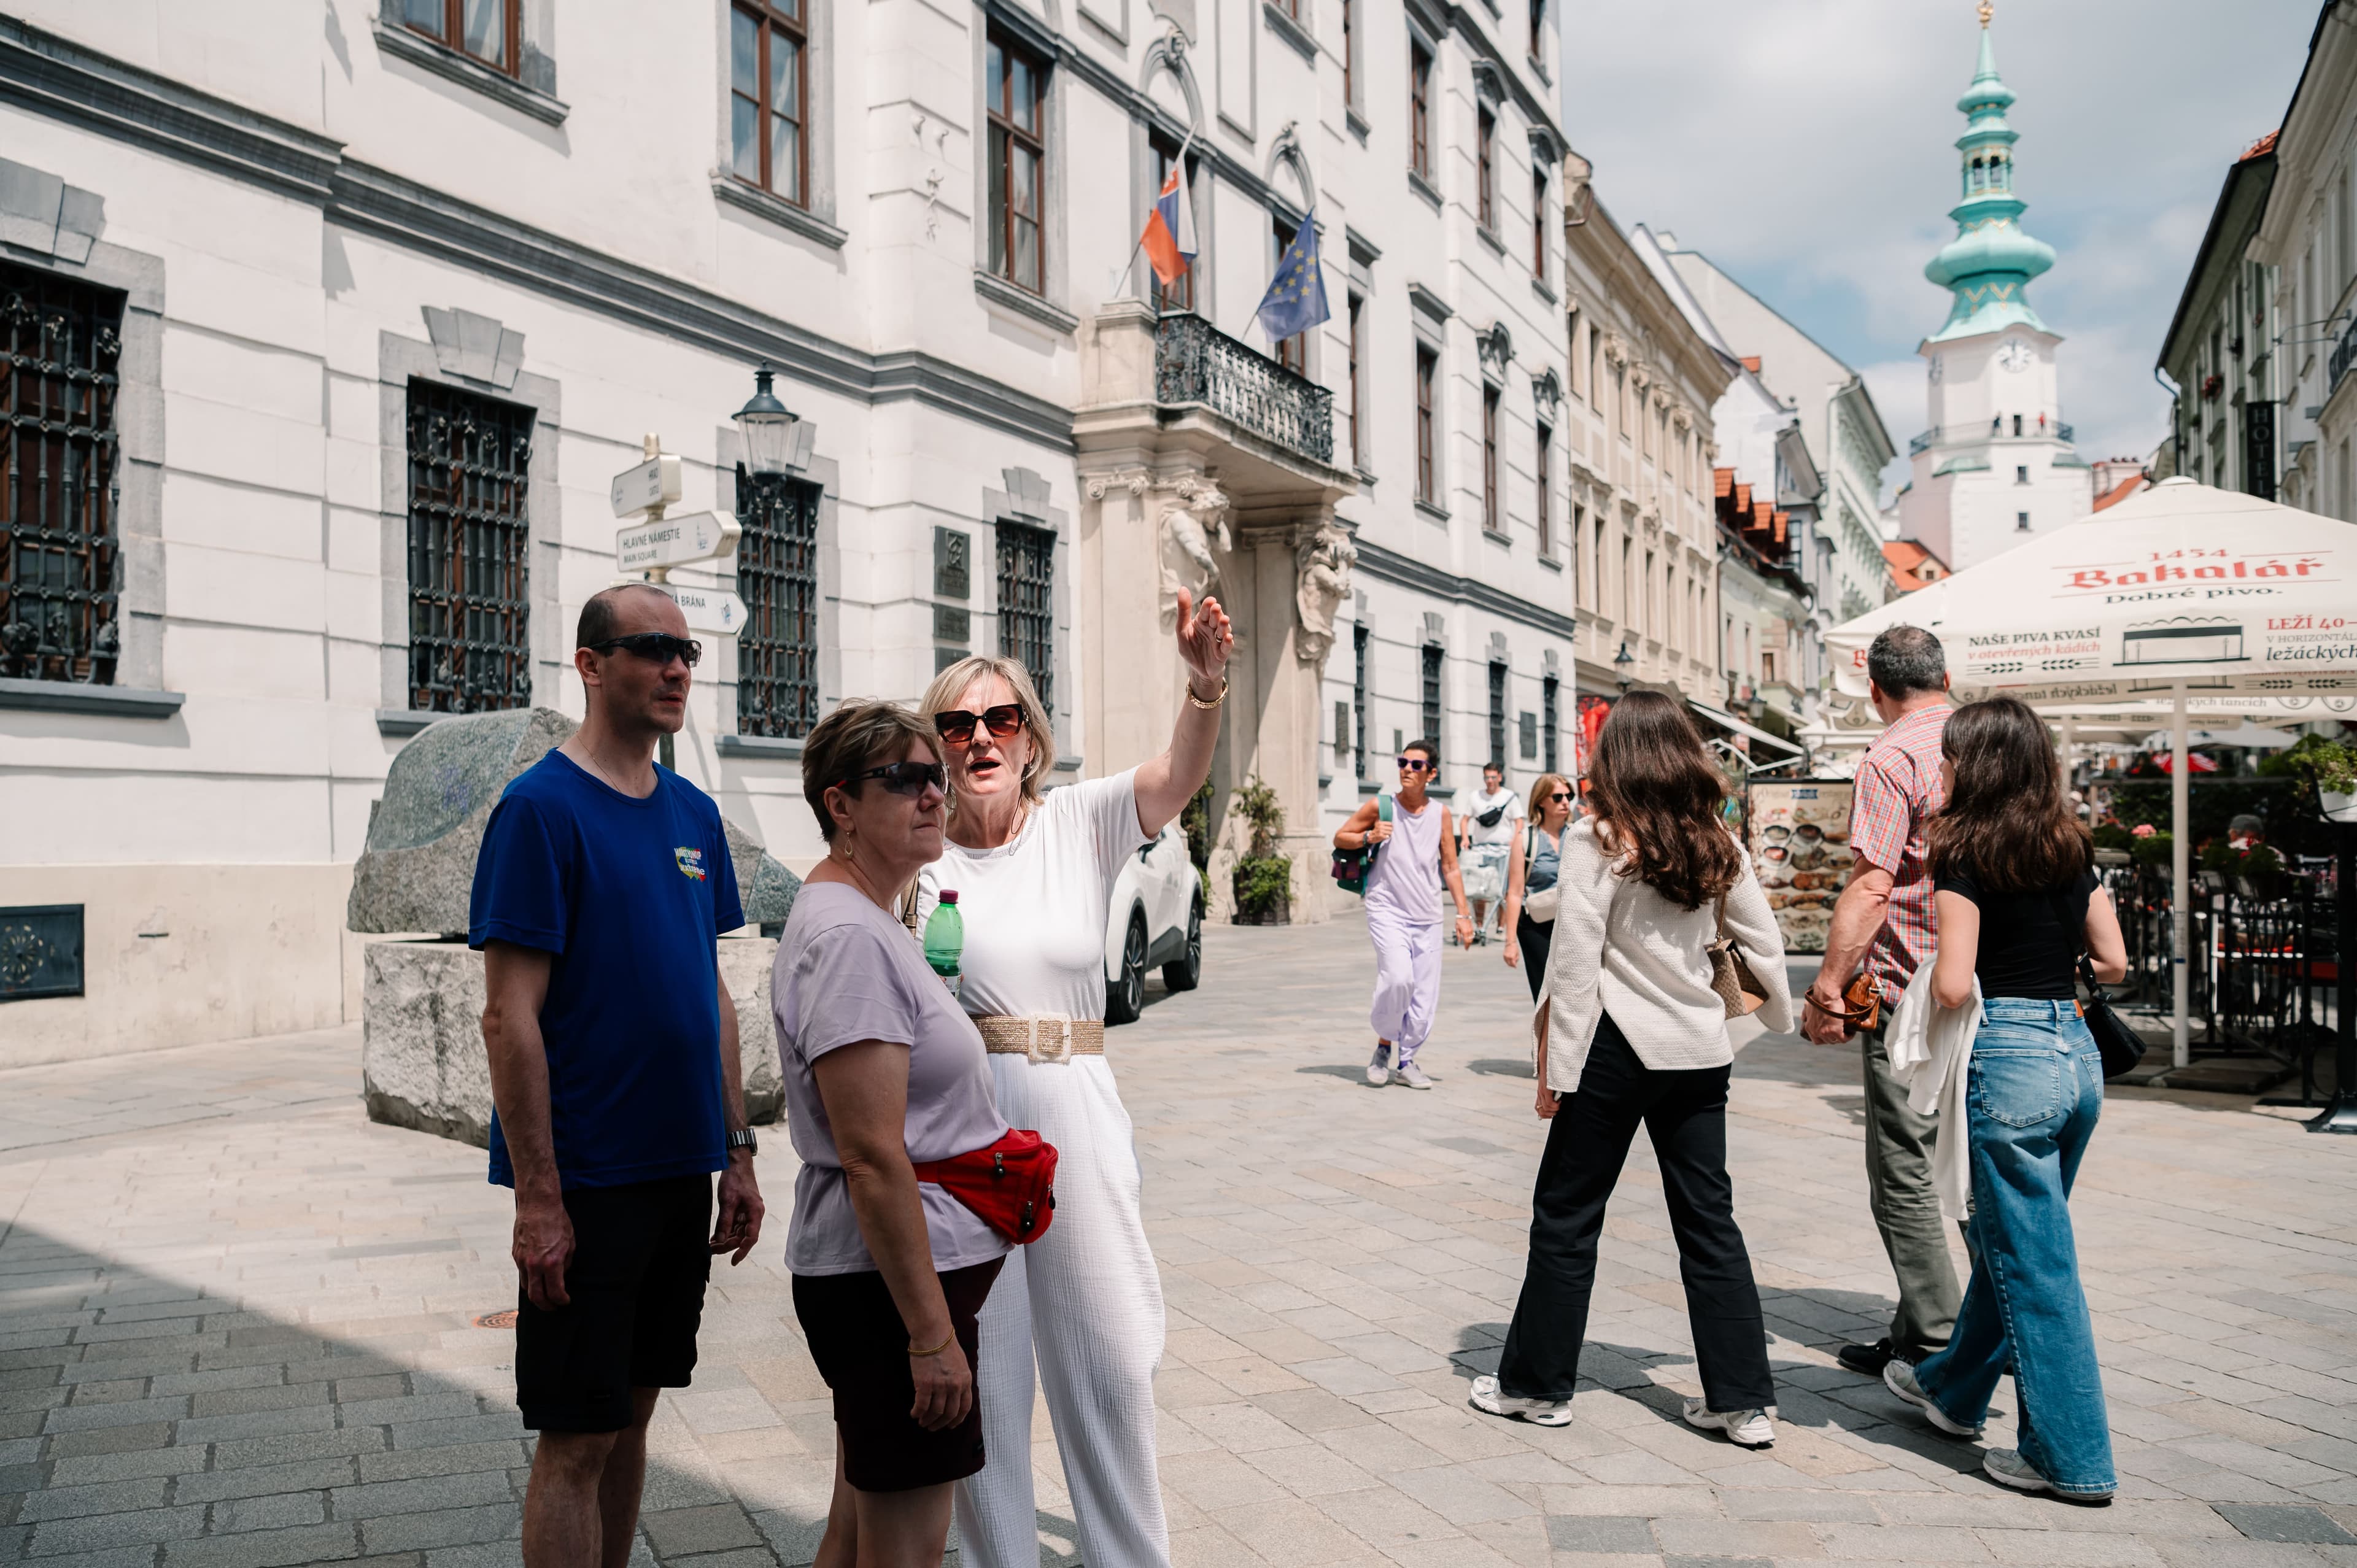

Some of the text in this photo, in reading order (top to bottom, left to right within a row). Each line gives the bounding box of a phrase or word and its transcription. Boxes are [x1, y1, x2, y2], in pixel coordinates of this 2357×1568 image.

[2253, 408, 2270, 495] HOTEL
[623, 528, 681, 550] HLAVNÉ NÁMESTIE
[624, 549, 657, 564] MAIN SQUARE
[2150, 549, 2229, 562] 1454
[2062, 557, 2324, 589] Bakalář
[681, 594, 706, 609] BRÁNA
[2106, 586, 2283, 604] Dobré pivo.
[2267, 614, 2313, 630] LEŽÍ
[1969, 626, 2100, 646] NAŠE PIVA KVASÍ
[1978, 644, 2051, 660] otevřených
[2056, 641, 2100, 654] kádích
